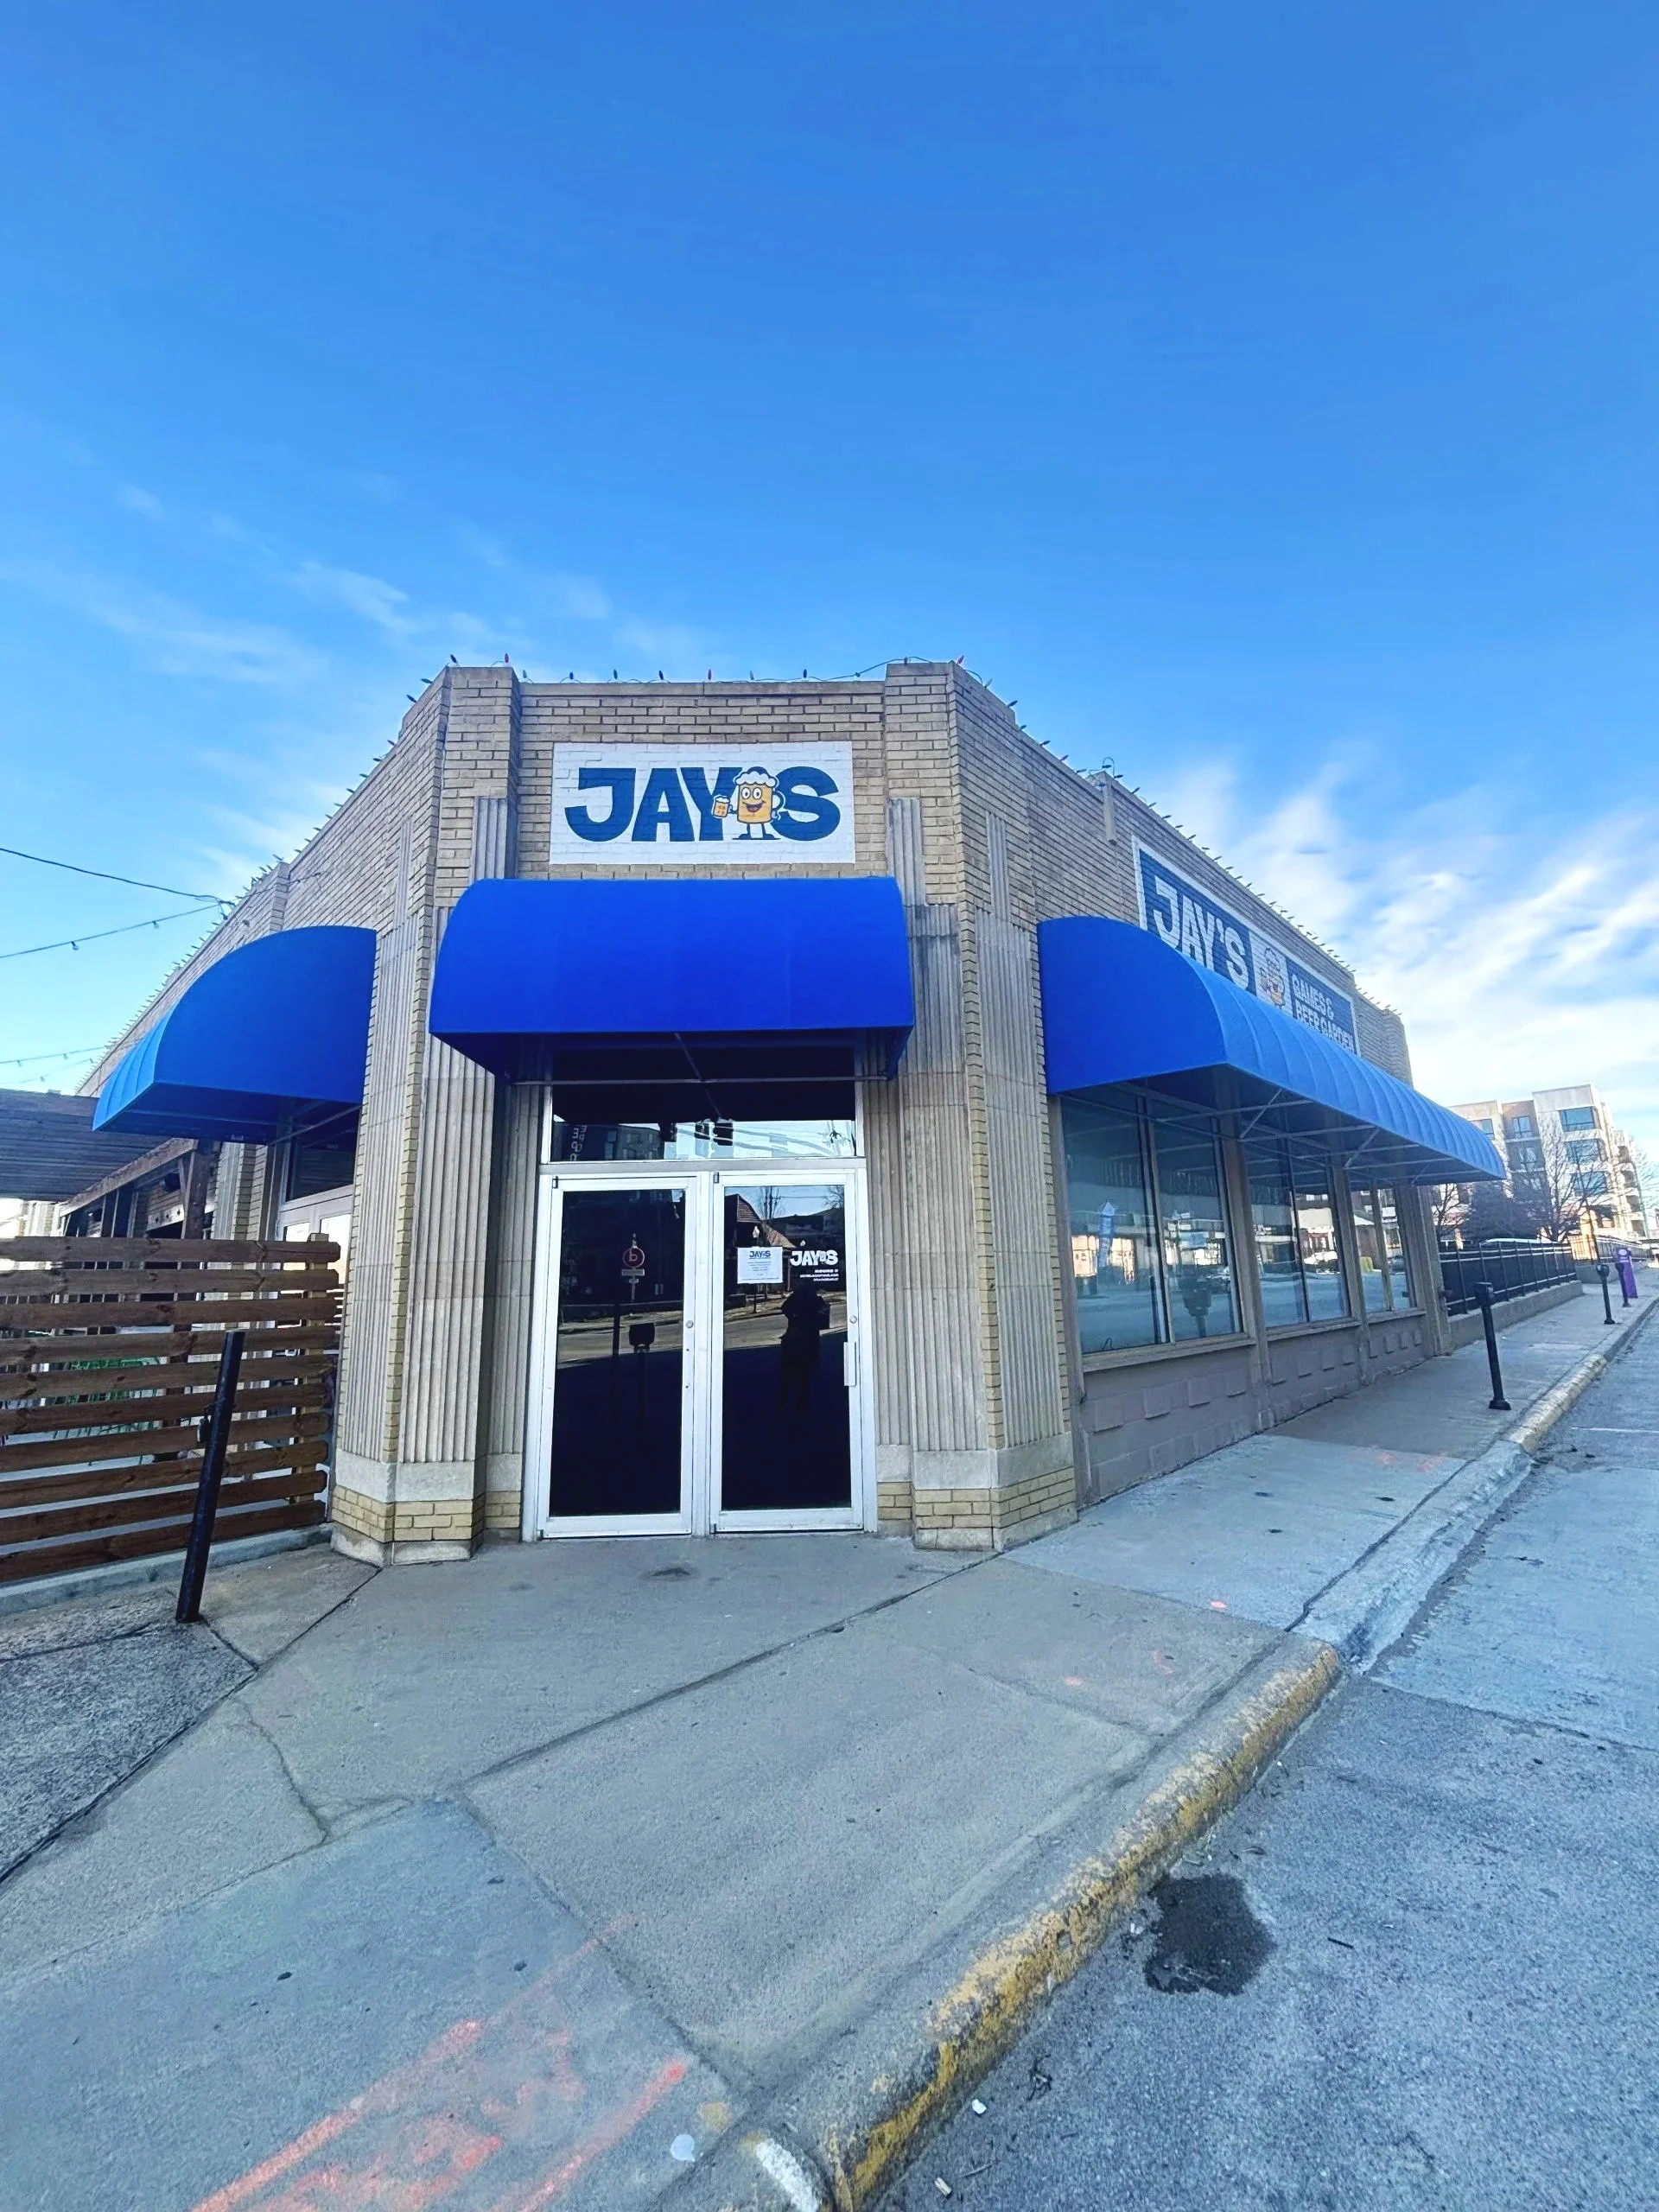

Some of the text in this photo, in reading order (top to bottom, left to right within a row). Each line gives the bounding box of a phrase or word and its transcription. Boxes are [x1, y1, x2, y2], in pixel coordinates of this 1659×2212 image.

[565, 766, 841, 842] JAYS
[1154, 875, 1249, 990] JAY'S
[1292, 973, 1327, 1016] GAMES
